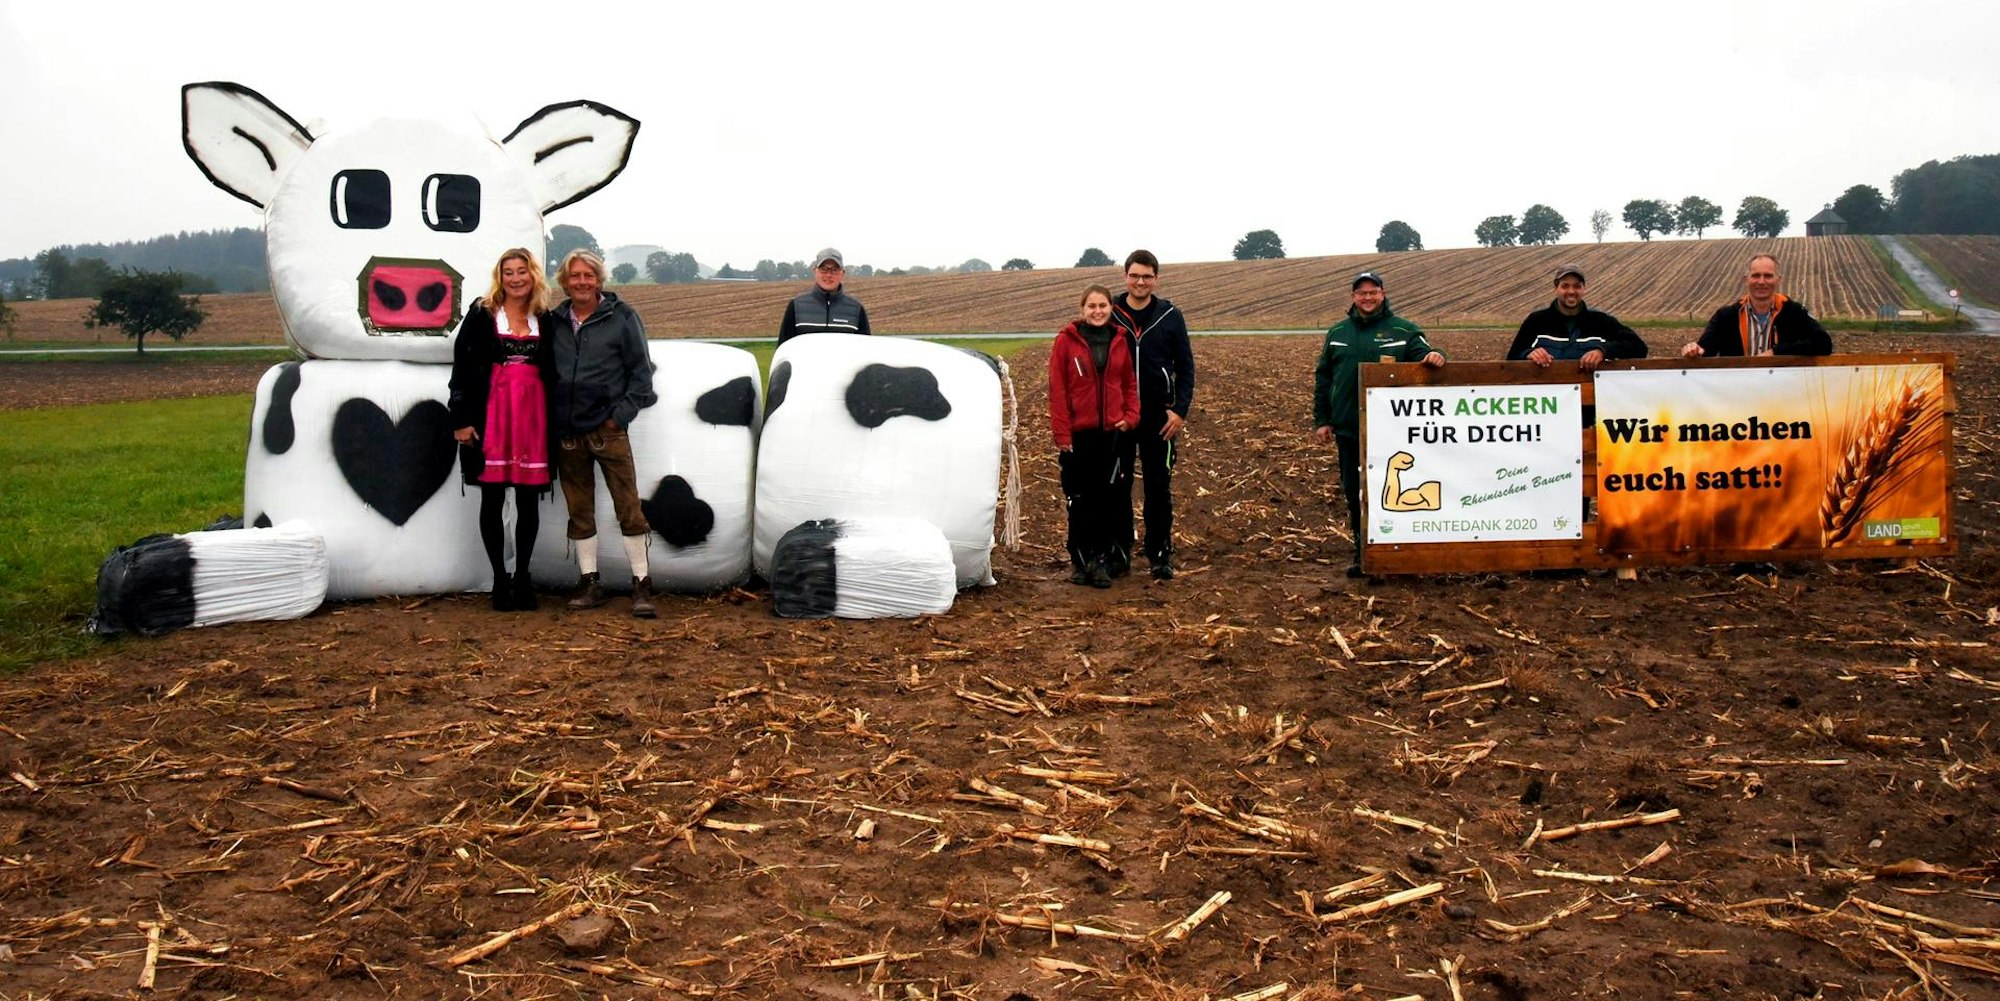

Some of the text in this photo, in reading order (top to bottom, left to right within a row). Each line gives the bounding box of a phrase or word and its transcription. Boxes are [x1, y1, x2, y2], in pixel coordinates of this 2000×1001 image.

[1391, 396, 1558, 417] WIR ACKERN
[1407, 422, 1542, 444] FÜR DICH!
[1602, 416, 1812, 443] Wir machen
[1495, 465, 1530, 481] Deine
[1604, 463, 1783, 492] euch satt!!
[1460, 470, 1573, 508] Rheinischen Bauern
[1412, 518, 1538, 533] ERNTEDANK 2020
[1867, 524, 1902, 538] LAND
